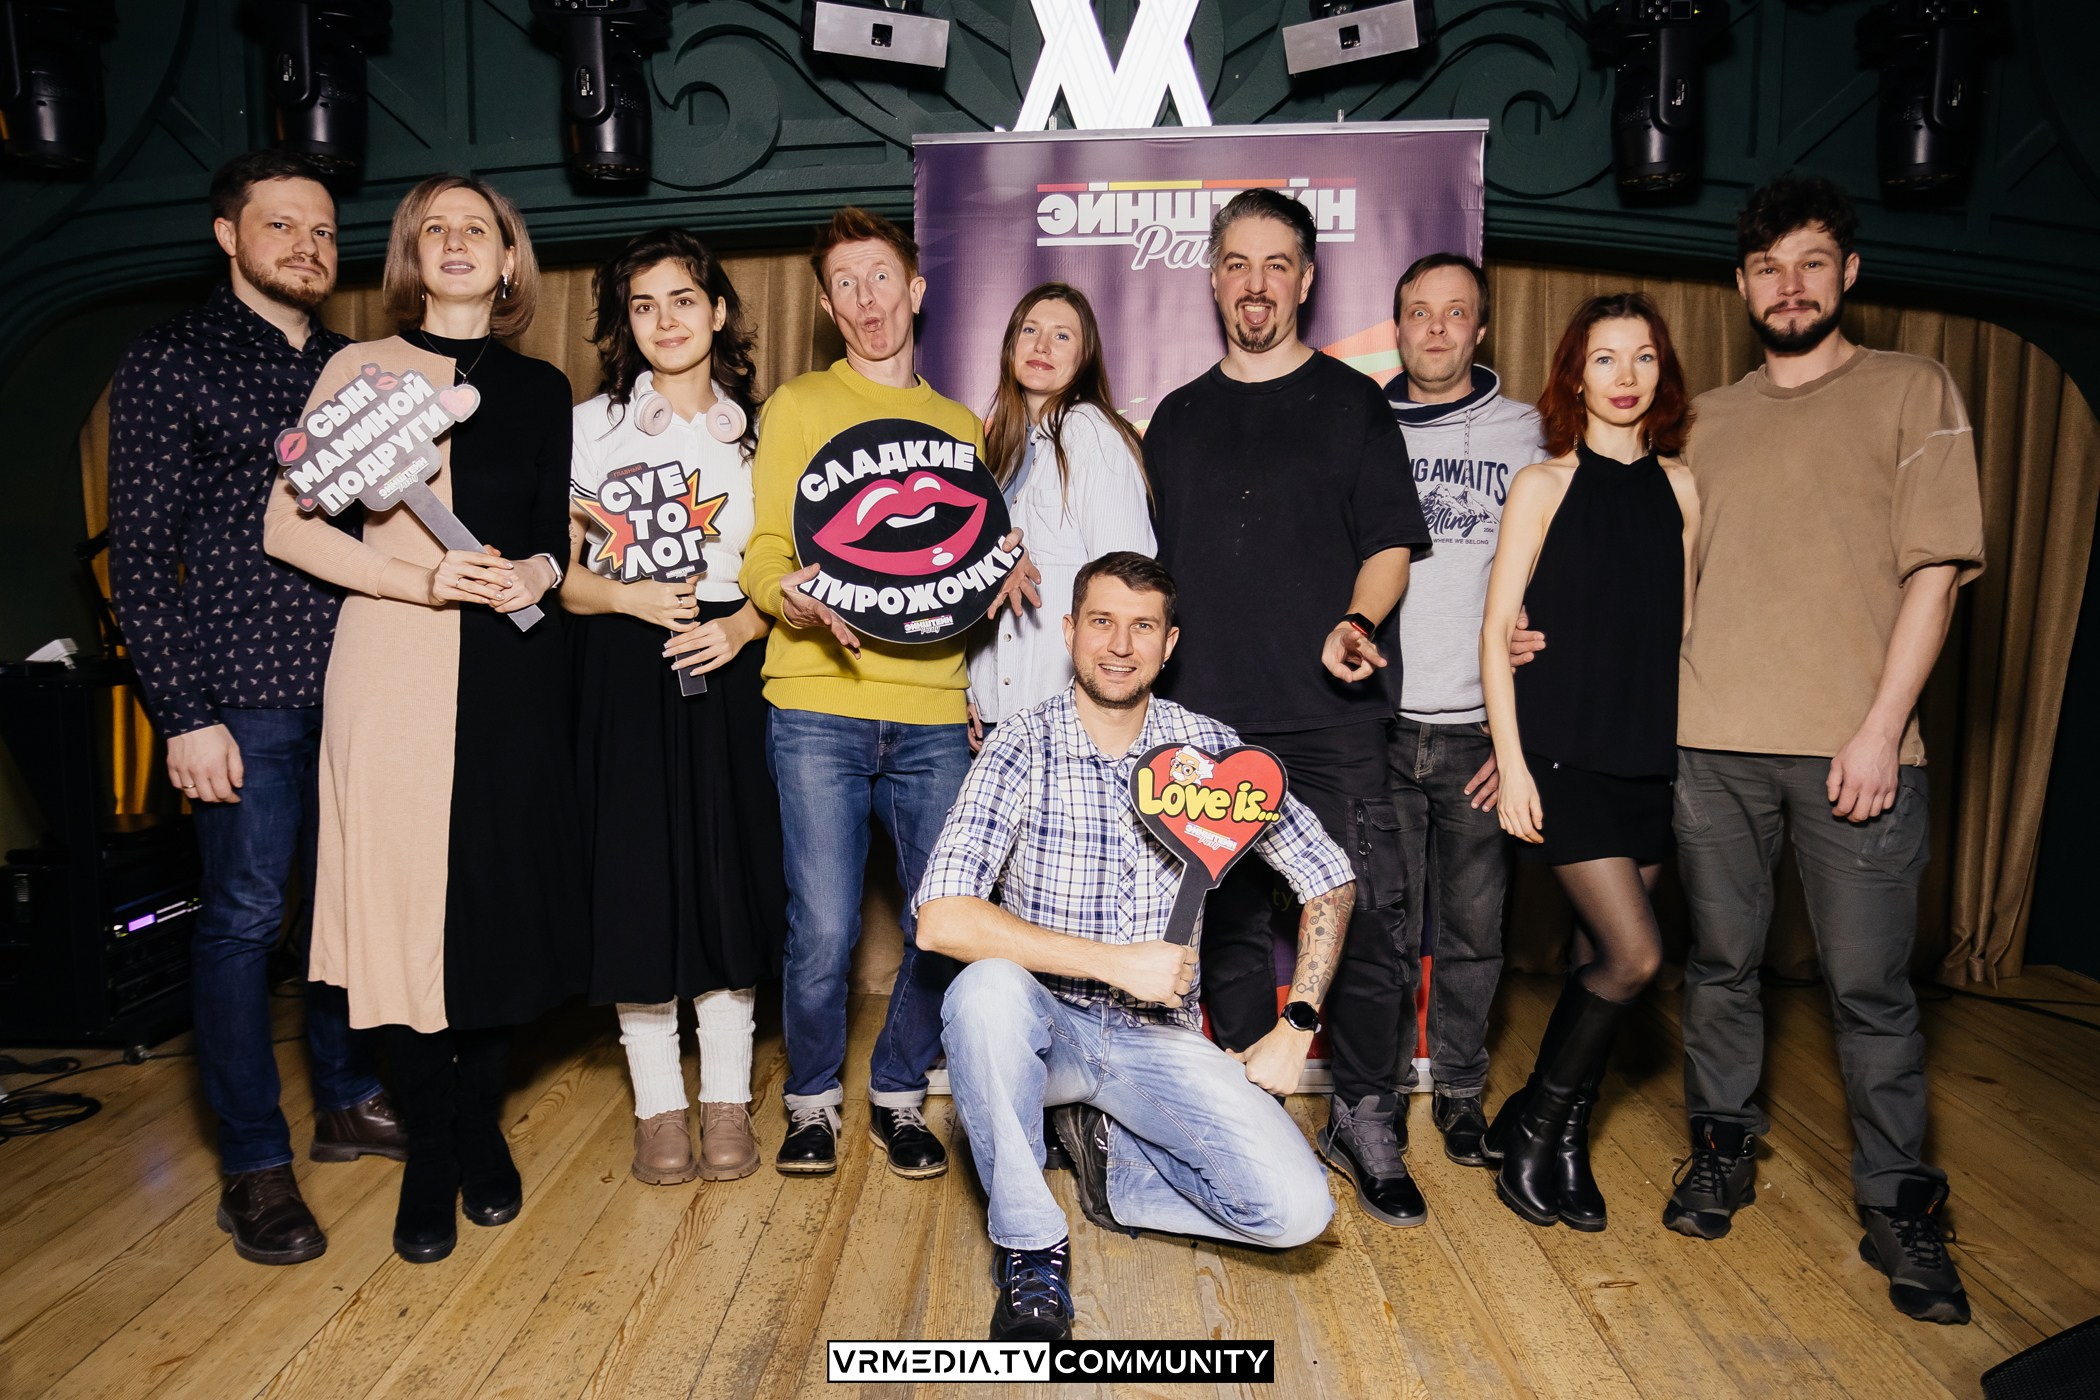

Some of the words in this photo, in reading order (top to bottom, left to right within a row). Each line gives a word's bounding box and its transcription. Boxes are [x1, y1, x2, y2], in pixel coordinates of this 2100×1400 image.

[289, 373, 435, 494] МАМИНОЙ
[307, 379, 378, 438] СЫН
[317, 404, 450, 512] ПОДРУГИ
[800, 440, 975, 502] СЛАДКИЕ
[1430, 458, 1508, 506] AWAITS
[601, 463, 687, 513] СУЕ
[629, 502, 688, 540] ТО
[1426, 507, 1480, 538] elling
[625, 529, 703, 579] ЛОГ
[1138, 767, 1231, 821] Love
[1233, 781, 1281, 822] is...
